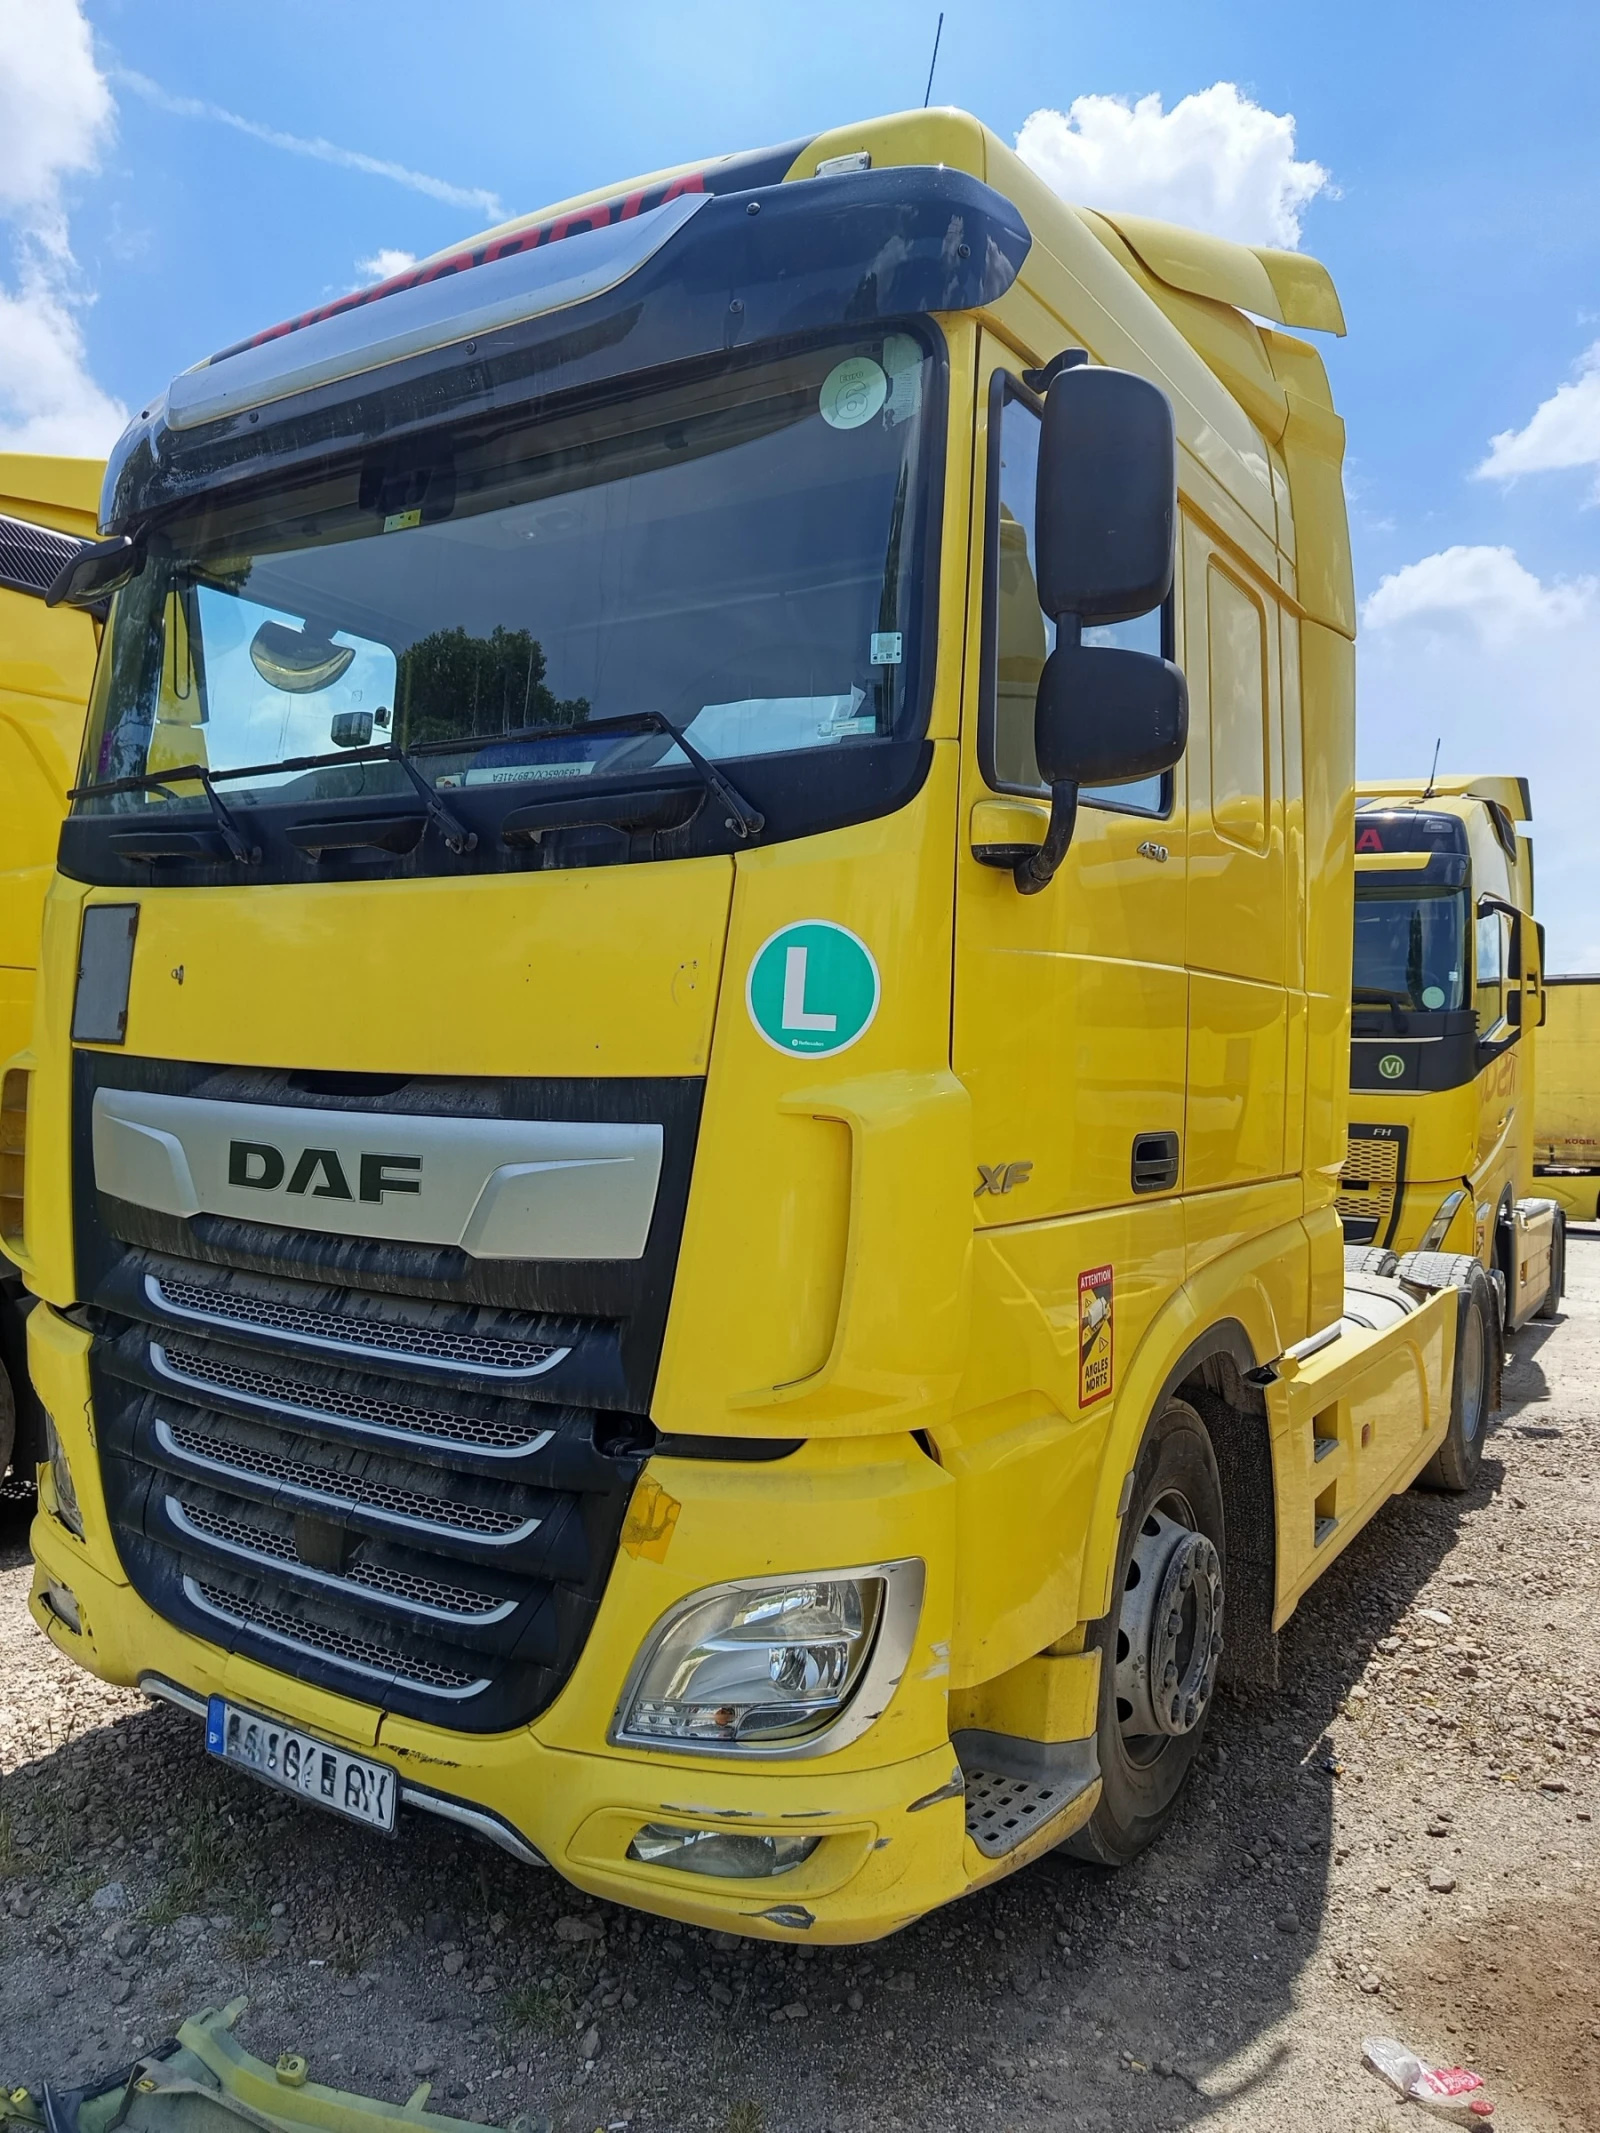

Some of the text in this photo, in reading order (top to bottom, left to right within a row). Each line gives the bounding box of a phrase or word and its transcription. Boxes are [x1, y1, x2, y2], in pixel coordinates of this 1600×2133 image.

[835, 381, 869, 420] 6
[782, 947, 837, 1032] L
[1383, 1061, 1400, 1074] VI
[1373, 1128, 1392, 1137] FH
[228, 1138, 423, 1204] DAF
[974, 1161, 1034, 1197] XF
[1080, 1268, 1111, 1288] ATTENTION
[1084, 1357, 1109, 1380] ANGLES
[1086, 1371, 1108, 1393] MORTS
